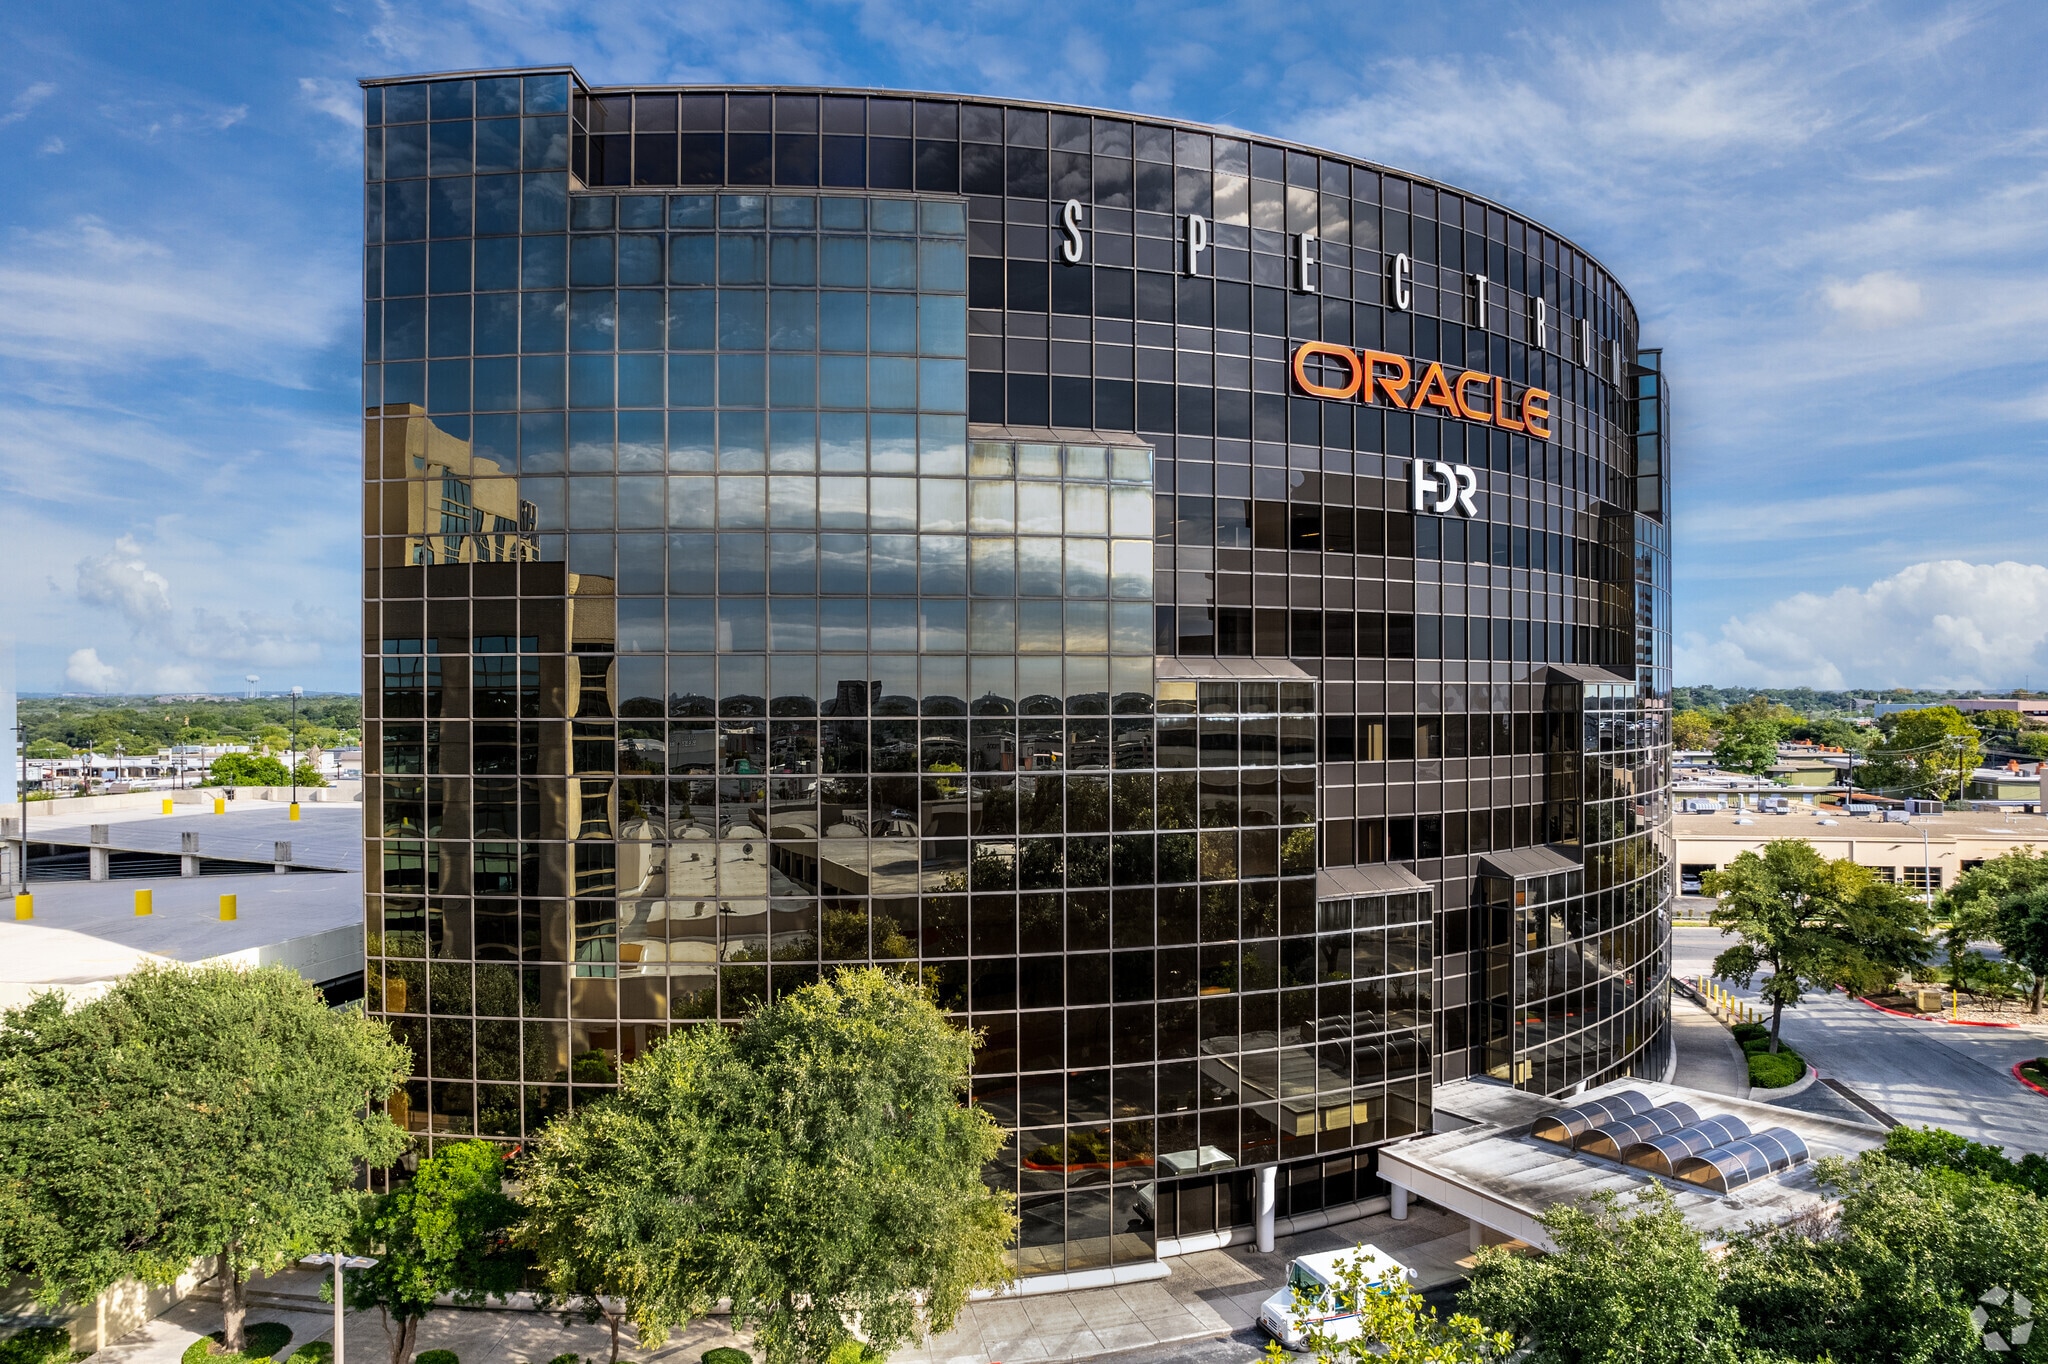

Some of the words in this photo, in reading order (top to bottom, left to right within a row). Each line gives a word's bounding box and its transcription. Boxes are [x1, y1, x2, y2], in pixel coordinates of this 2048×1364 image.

[1063, 198, 1620, 388] SPECTRUM
[1294, 341, 1551, 439] ORACLE
[1413, 458, 1478, 517] HDR
